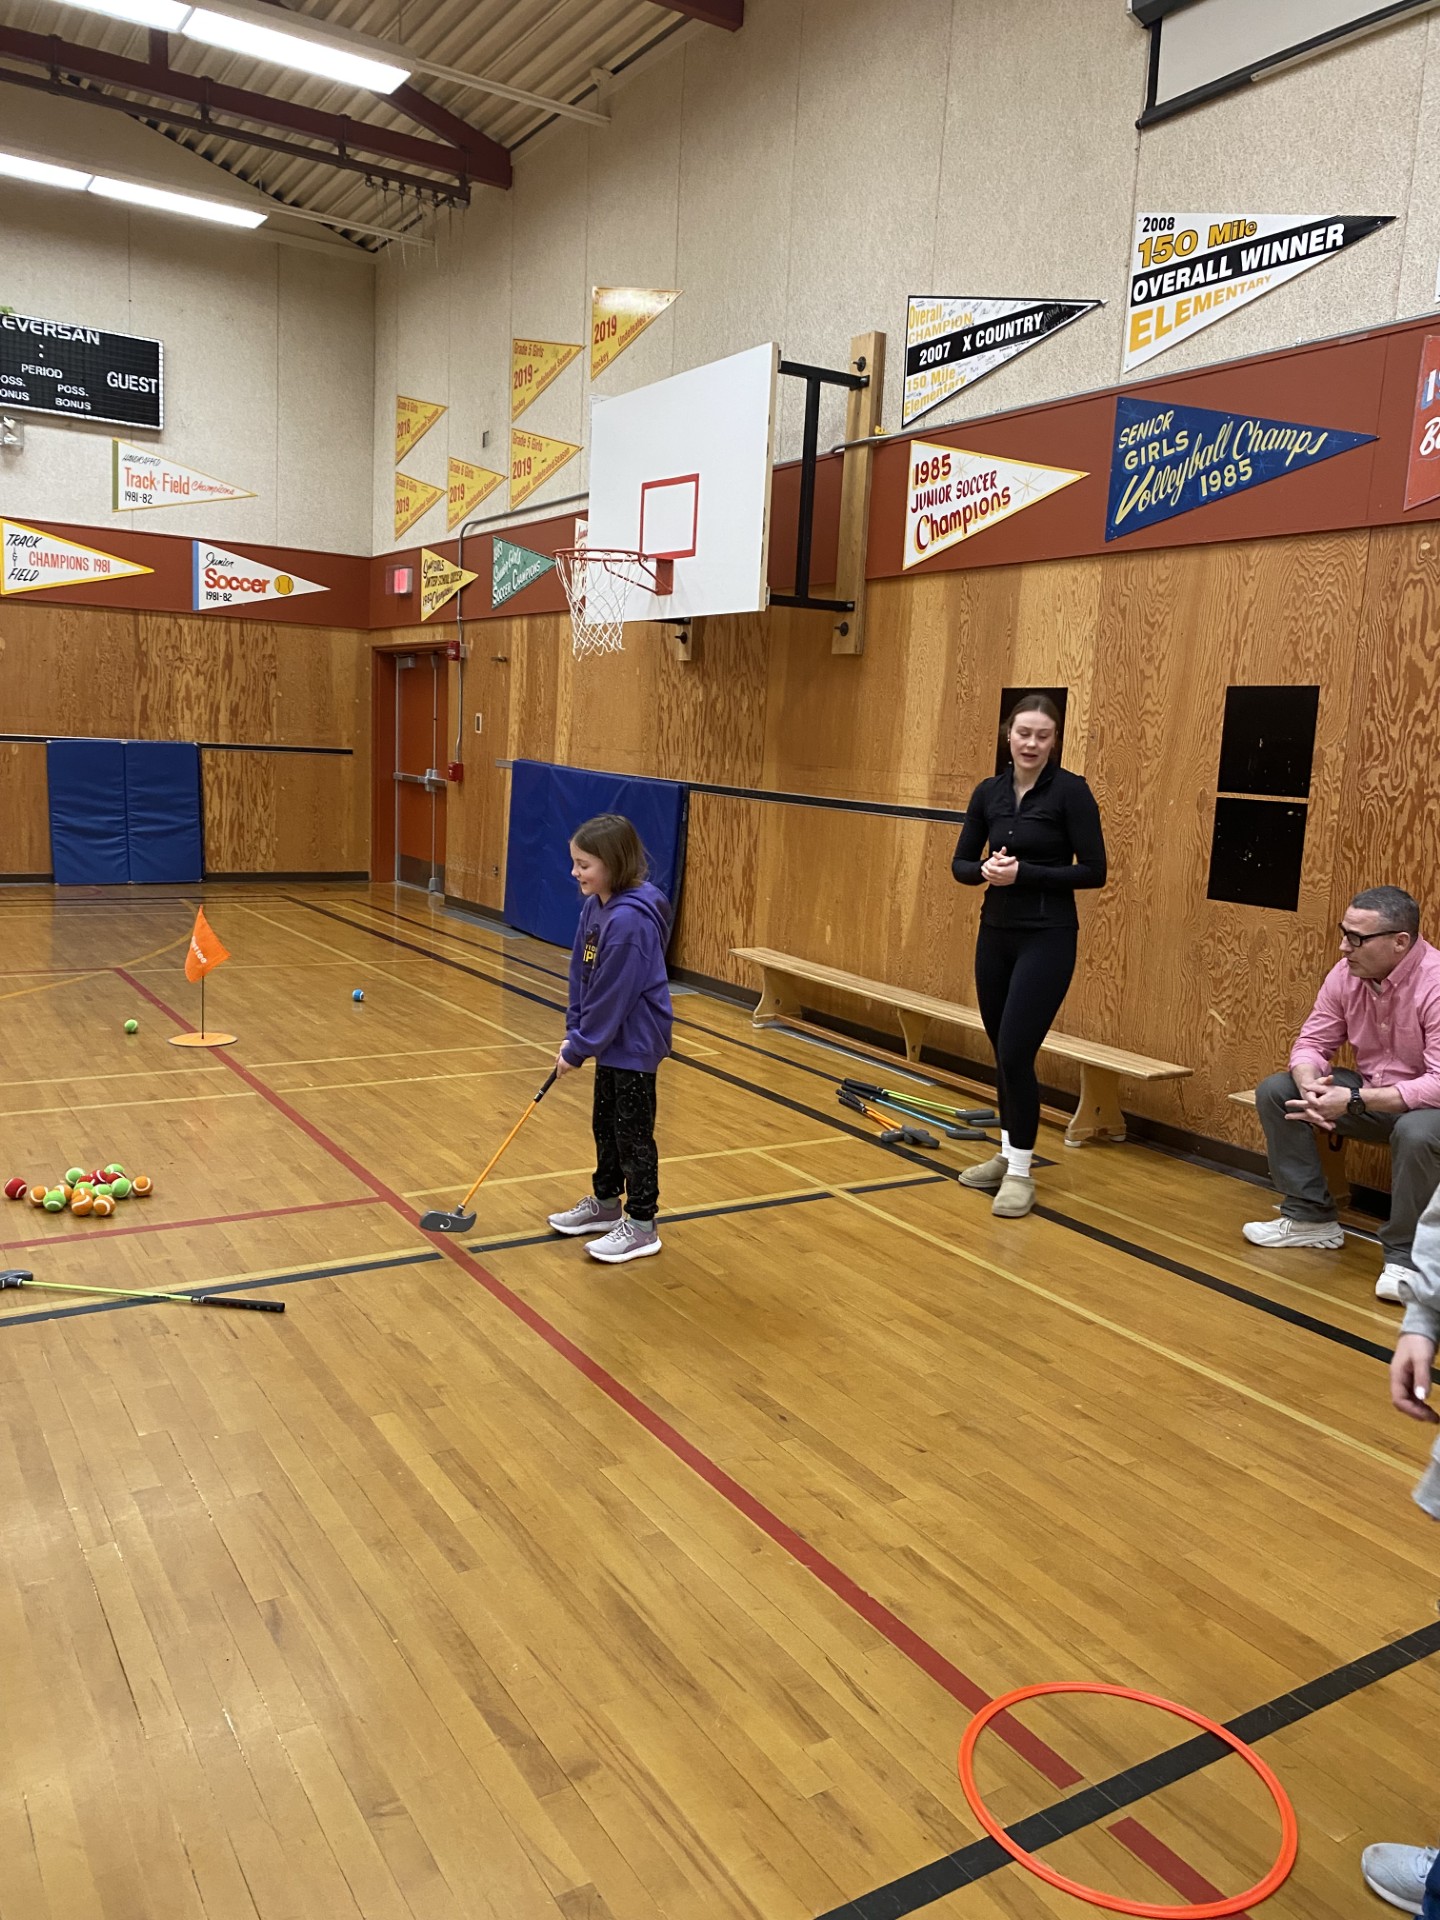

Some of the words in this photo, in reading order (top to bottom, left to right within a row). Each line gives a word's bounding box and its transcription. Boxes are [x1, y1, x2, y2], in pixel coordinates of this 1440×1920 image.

[1142, 216, 1176, 232] 2008
[1138, 229, 1199, 268] 150
[1207, 218, 1258, 249] Mile
[1133, 255, 1232, 302] OVERALL
[1240, 223, 1345, 272] WINNER
[909, 304, 943, 330] Overall
[1129, 274, 1272, 353] ELEMENTARY
[2, 316, 100, 345] EVERSAN
[594, 314, 617, 345] 2019
[908, 312, 973, 345] CHAMPION
[919, 341, 951, 366] 2007
[962, 333, 973, 353] X
[975, 311, 1044, 348] COUNTRY
[21, 363, 63, 379] PERIOD
[106, 371, 158, 394] GUEST
[513, 364, 533, 390] 2019
[907, 375, 927, 393] 150
[931, 367, 956, 386] Mile
[0, 374, 26, 387] OSS.
[57, 384, 89, 397] POSS.
[904, 375, 967, 417] Elementary
[0, 388, 30, 401] ONUS
[55, 397, 92, 411] BONUS
[512, 432, 527, 447] Grade
[1118, 410, 1175, 449] SENIOR
[1124, 430, 1189, 470] GIRLS
[125, 467, 157, 491] Track
[162, 473, 190, 495] Field
[512, 456, 532, 480] 2019
[912, 453, 952, 487] 1985
[1115, 420, 1234, 525] Volleyball
[1232, 420, 1328, 467] Champs
[1200, 458, 1252, 496] 1985
[125, 490, 153, 504] 1981-82
[449, 483, 464, 504] 2019
[911, 484, 952, 514] JUNIOR
[956, 469, 998, 500] SOCCER
[396, 496, 409, 515] 2019
[914, 486, 1012, 552] Champions
[6, 533, 42, 548] TRACK
[28, 551, 90, 572] CHAMPIONS
[93, 558, 111, 573] 1981
[203, 552, 235, 569] Junior
[8, 567, 40, 581] FIELD
[204, 568, 270, 593] Soccer
[512, 559, 540, 590] CHAMPIONS
[206, 591, 232, 602] 1981-82
